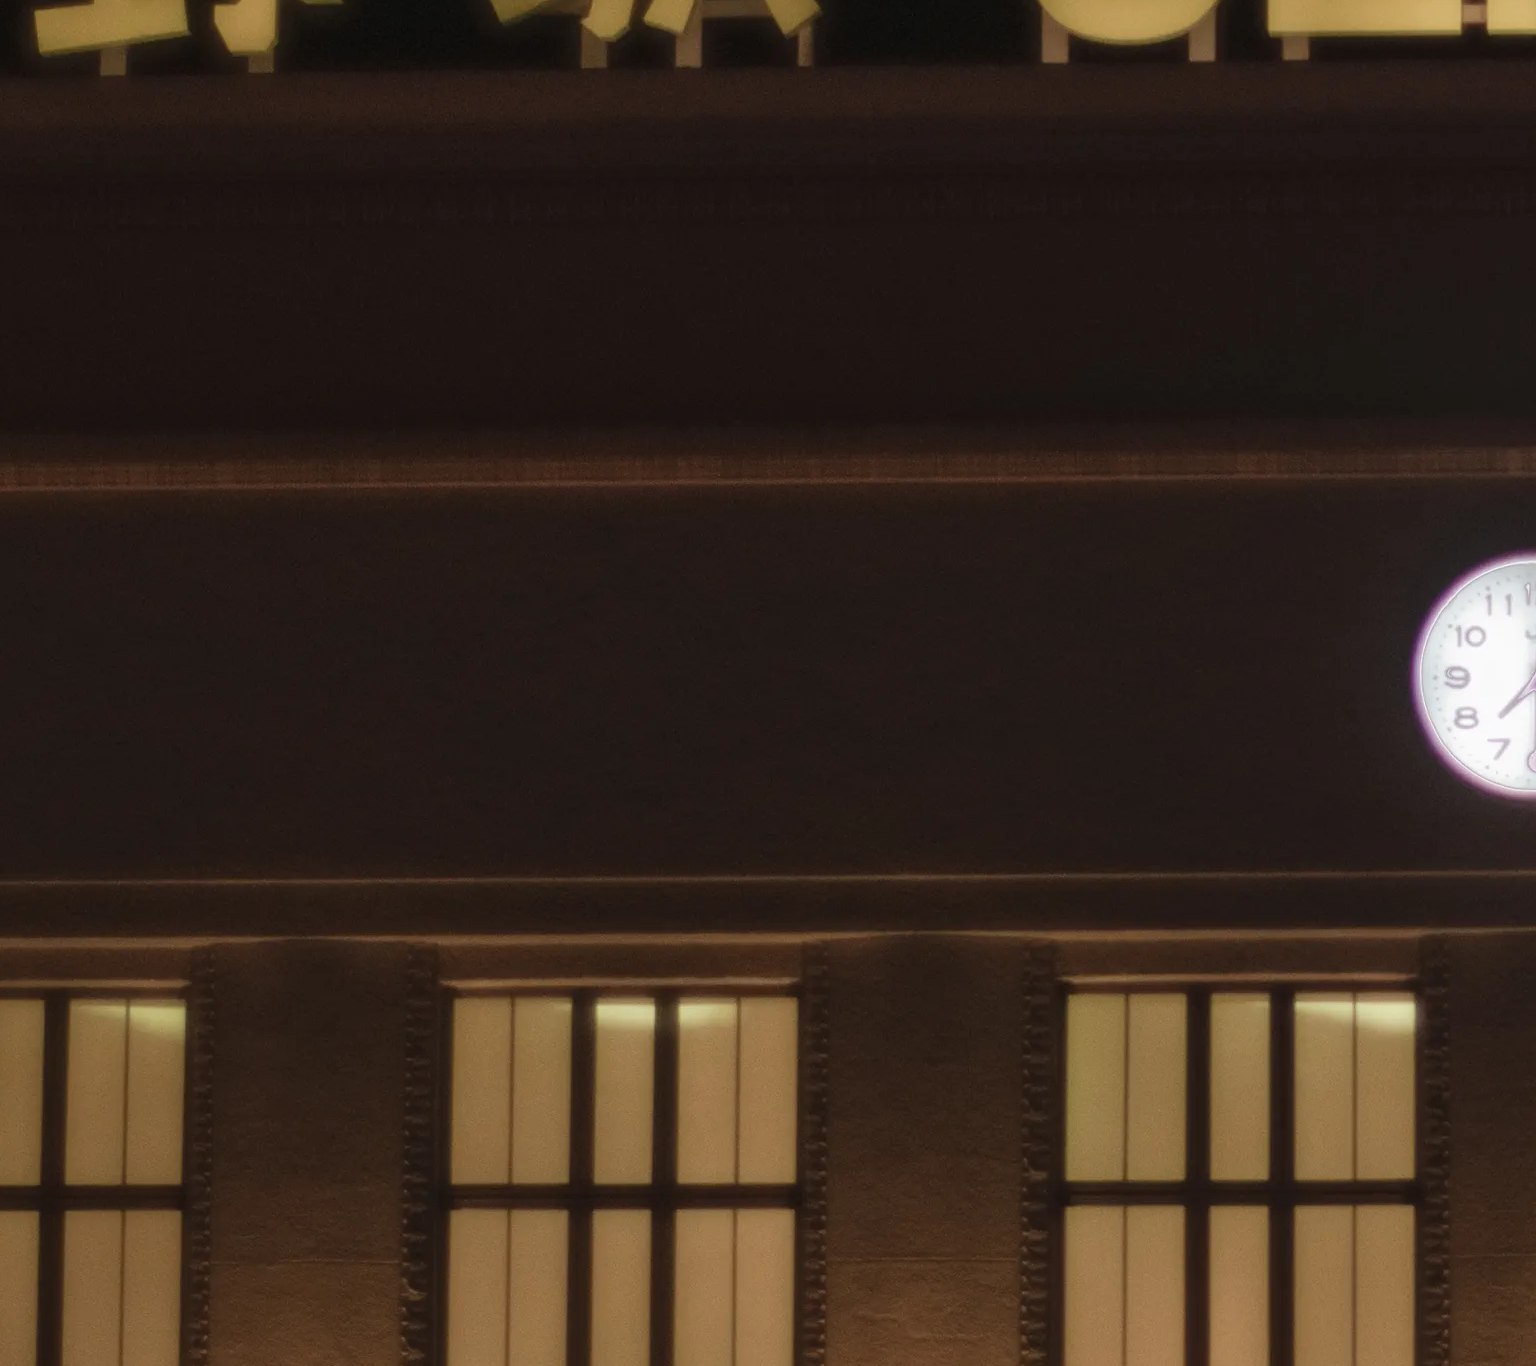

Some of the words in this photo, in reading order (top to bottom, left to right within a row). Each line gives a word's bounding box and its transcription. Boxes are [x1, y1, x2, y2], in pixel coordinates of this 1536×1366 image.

[1485, 593, 1512, 617] 11
[1455, 624, 1486, 647] 10
[1444, 666, 1471, 690] 9
[1453, 706, 1479, 730] 8
[1487, 738, 1510, 761] 7
